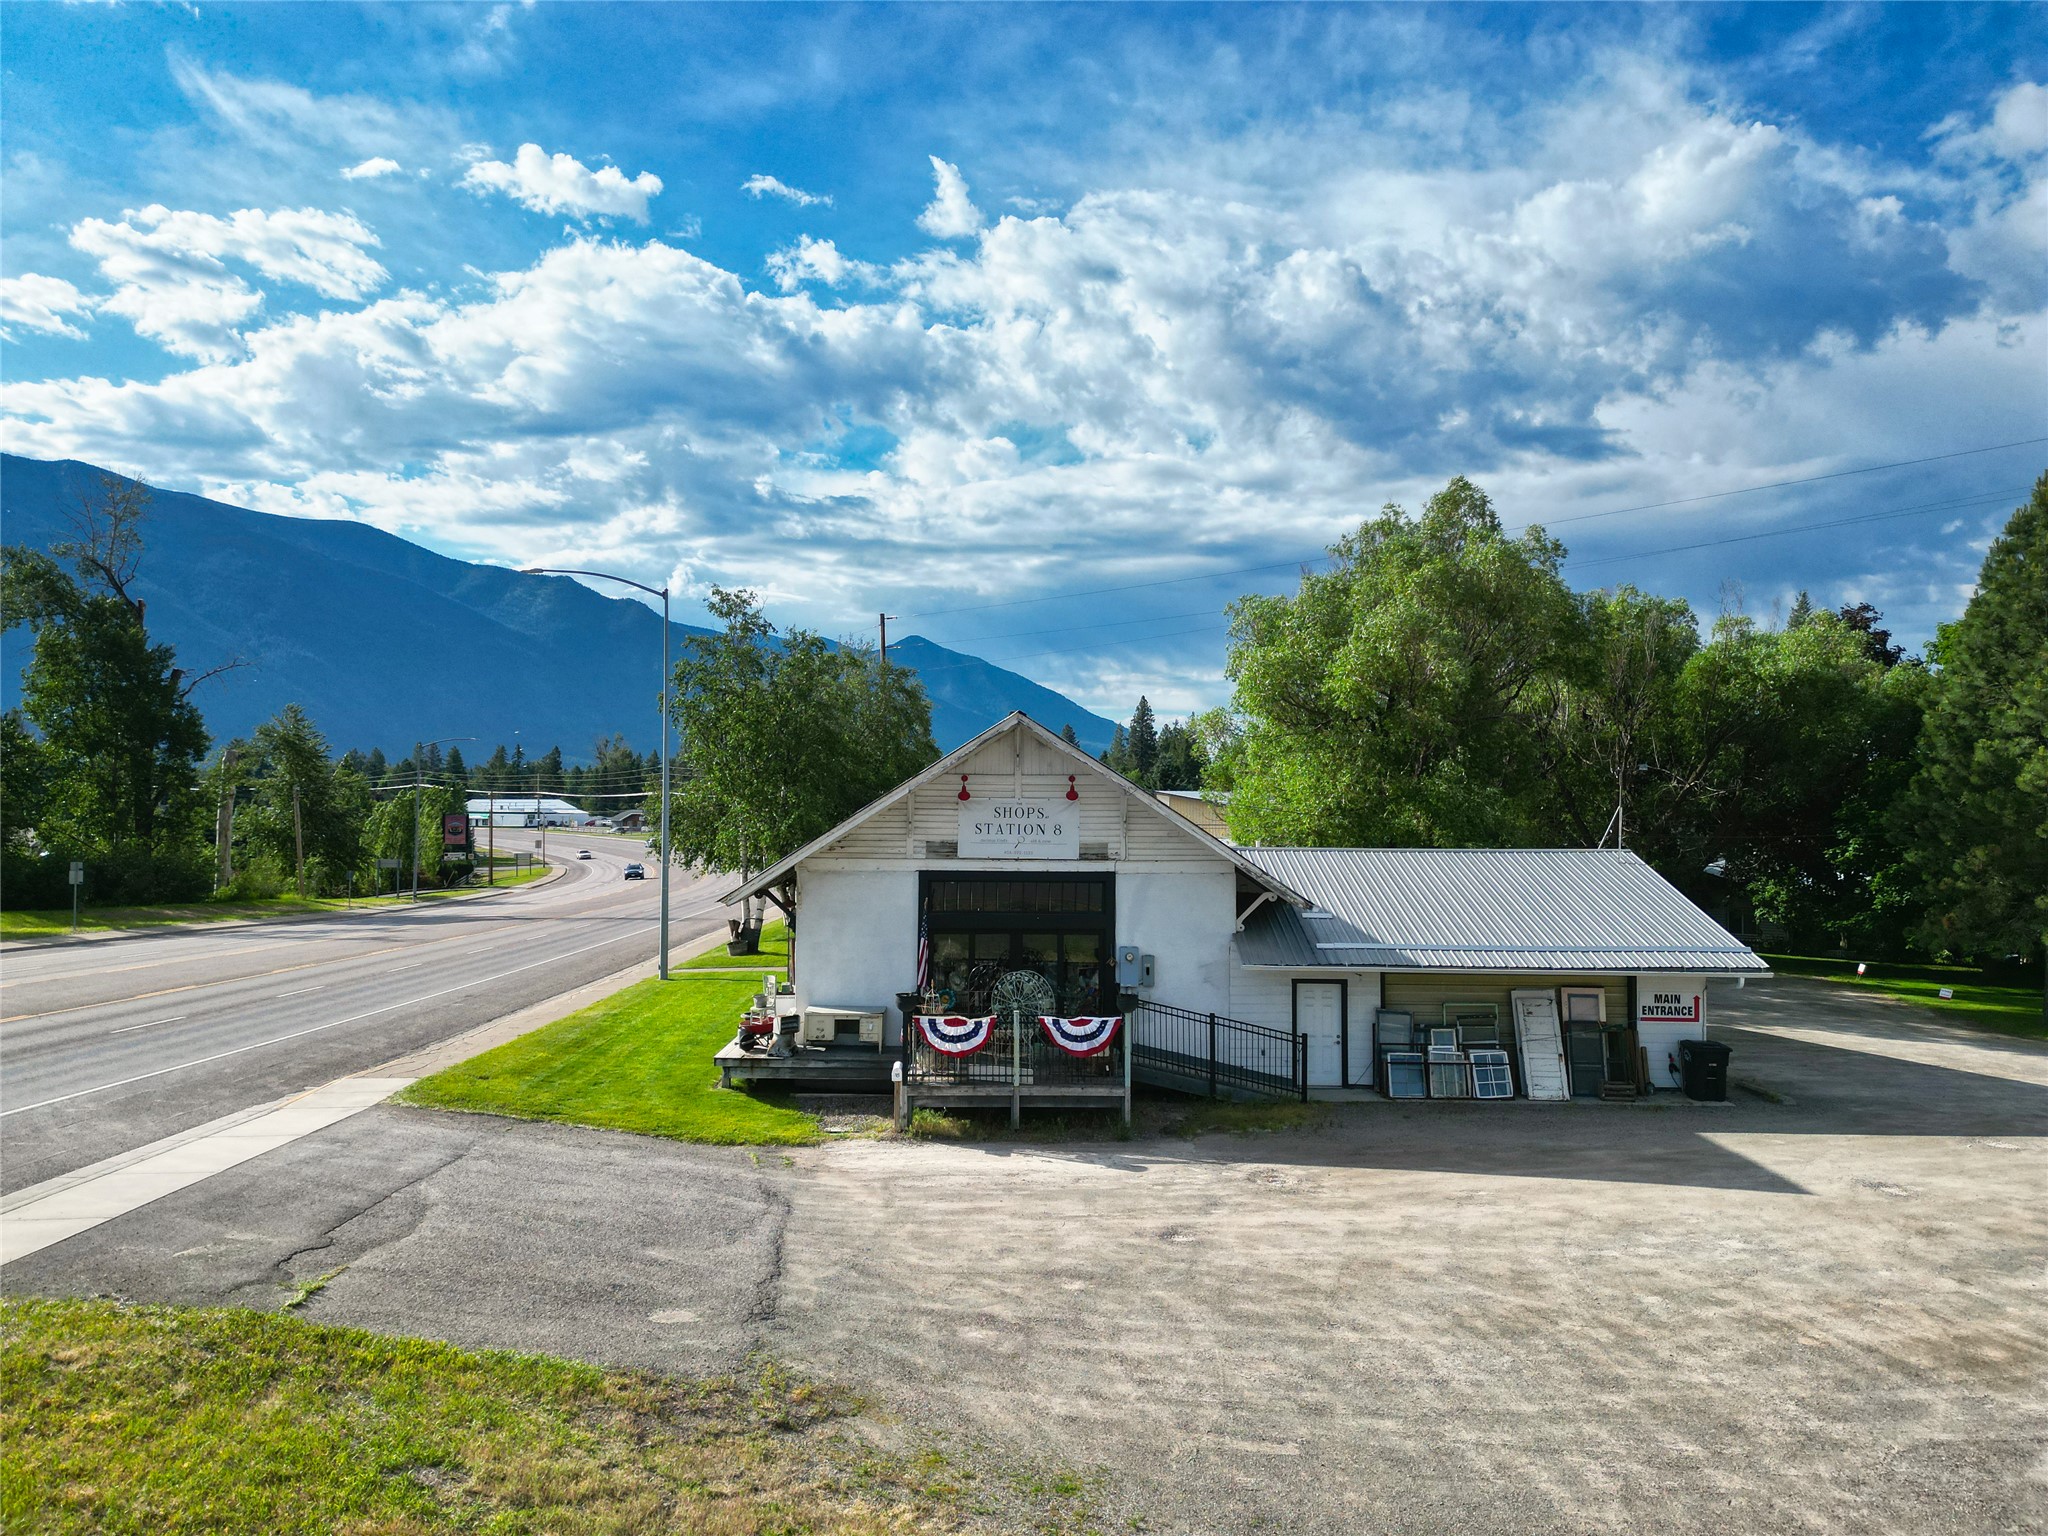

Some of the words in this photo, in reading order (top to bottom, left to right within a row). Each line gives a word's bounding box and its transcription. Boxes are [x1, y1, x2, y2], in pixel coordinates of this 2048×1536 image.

[994, 807, 1045, 819] SHOPS
[975, 823, 1046, 835] STATION
[1053, 824, 1062, 836] 8
[1654, 994, 1681, 1004] MAIN
[1642, 1006, 1693, 1016] ENTRANCE
